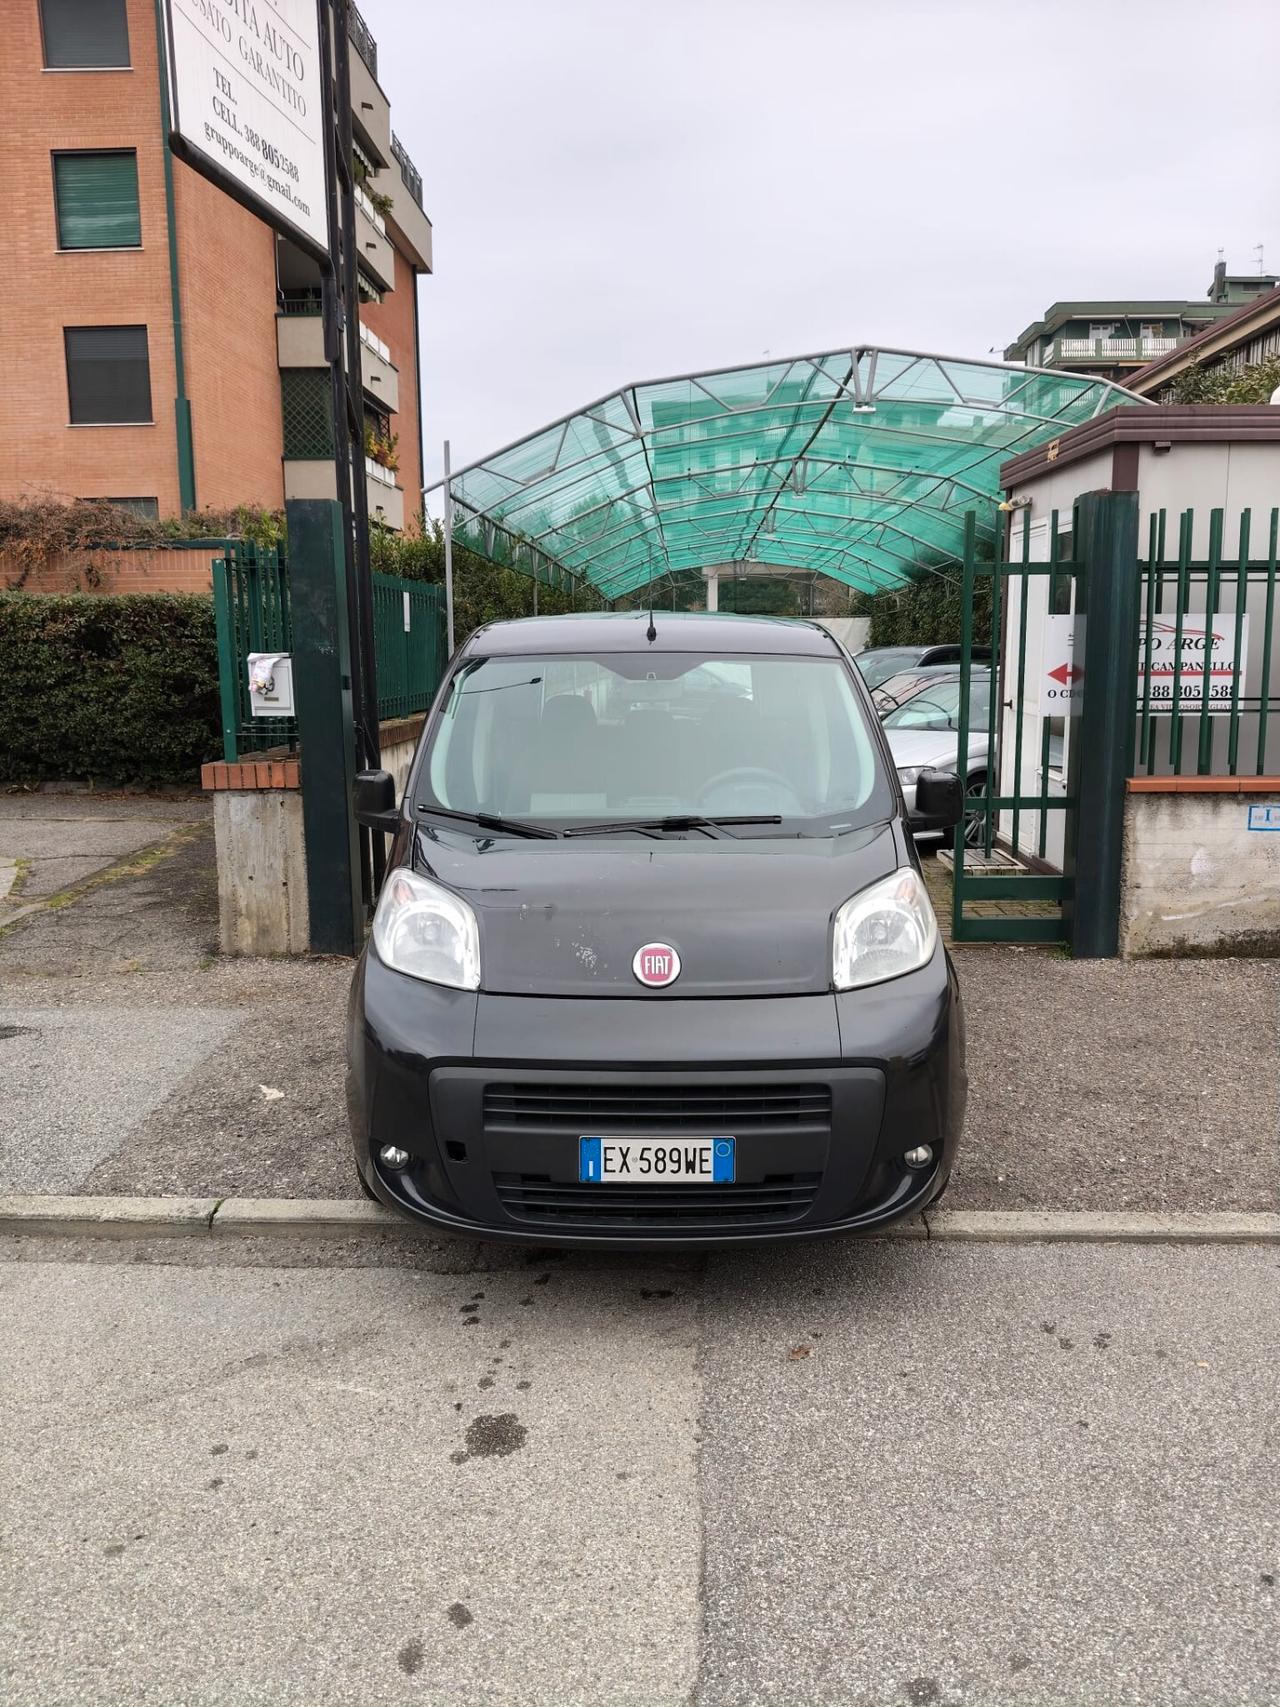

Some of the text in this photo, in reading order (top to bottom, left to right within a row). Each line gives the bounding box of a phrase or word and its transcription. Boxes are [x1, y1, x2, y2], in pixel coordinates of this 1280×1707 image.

[264, 21, 304, 81] AUTO
[213, 67, 237, 105] TEL.
[239, 35, 306, 116] GARANTITO
[213, 96, 243, 137] CELL.
[204, 122, 311, 217] gruppoarge@gmail.com
[644, 955, 671, 975] FIAT
[603, 1147, 712, 1175] EX 589WE
